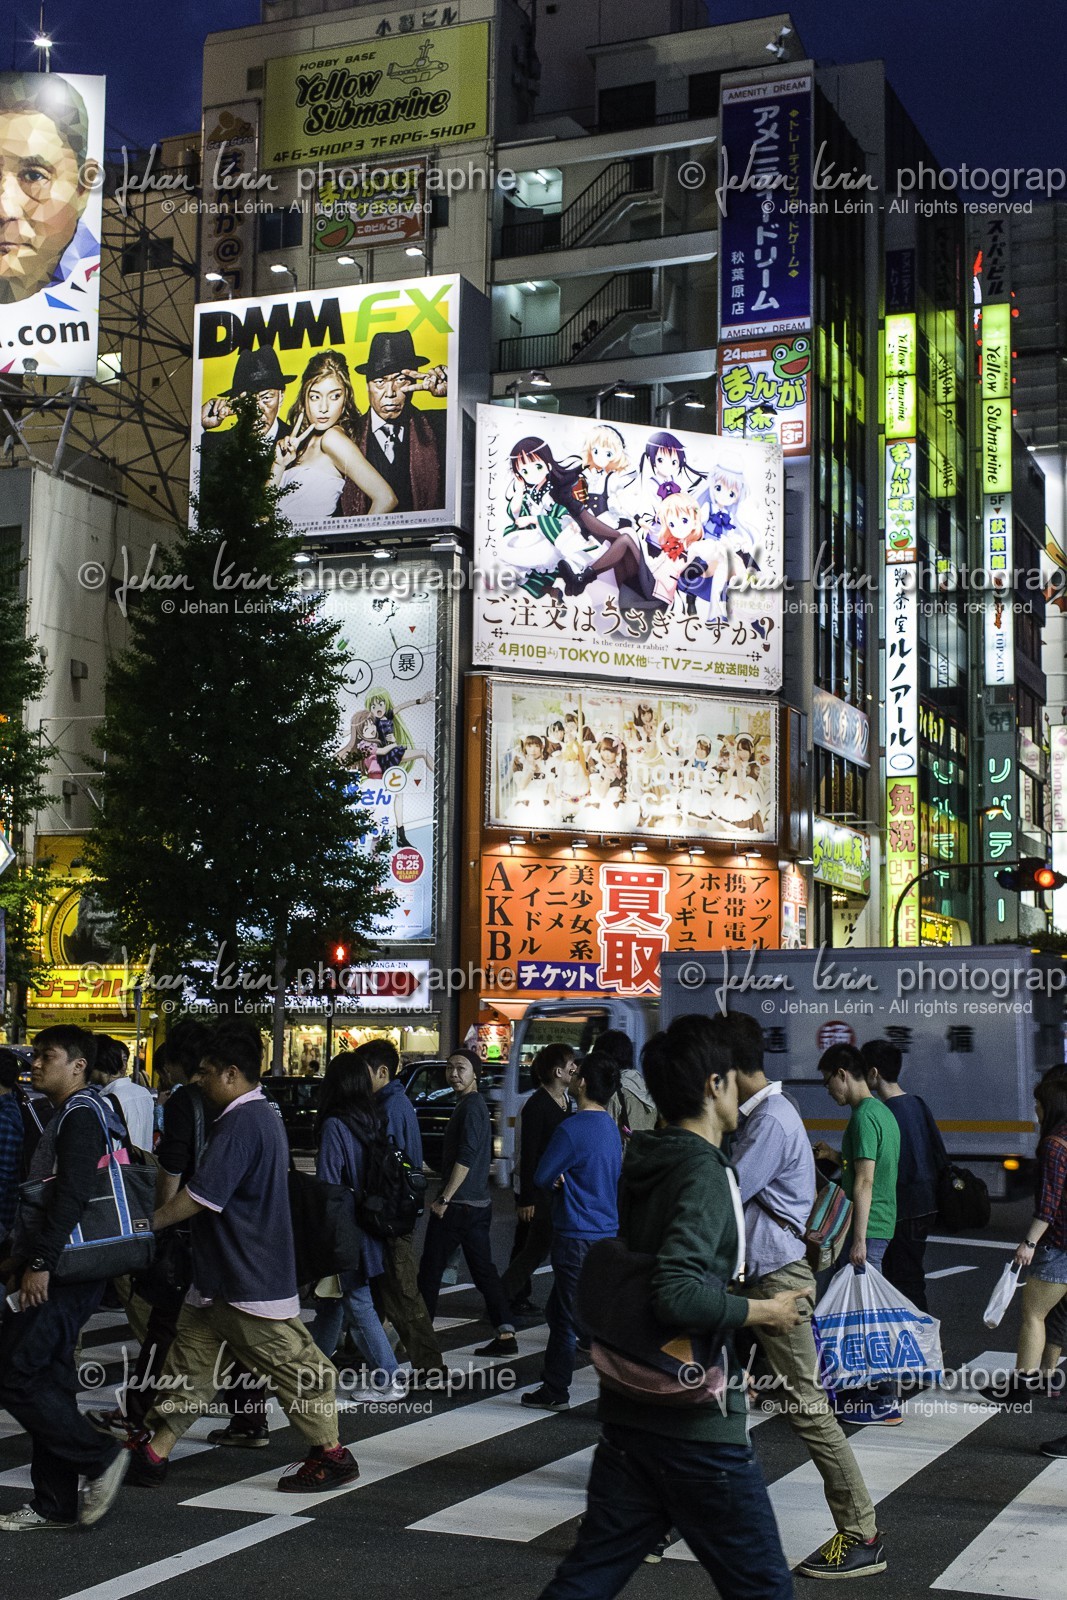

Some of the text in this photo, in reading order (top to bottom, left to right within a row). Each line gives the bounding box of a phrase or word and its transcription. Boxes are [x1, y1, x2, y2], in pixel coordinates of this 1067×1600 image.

[300, 51, 376, 71] HOBBY BASE
[296, 68, 383, 108] Yellow
[303, 88, 452, 136] Submarine
[728, 80, 807, 101] AMENITY DREAM
[730, 250, 746, 316] 秋葉原店
[0, 319, 91, 348] .com
[198, 283, 455, 360] DMM FX
[726, 321, 807, 339] AMENITY DREAM
[721, 364, 805, 408] まんが
[986, 346, 1002, 484] Yellow Submarine
[484, 434, 498, 558] ブレンドしました。
[889, 442, 912, 498] まんが
[763, 470, 778, 576] かわいさだけを、
[990, 494, 1006, 505] 5F
[398, 652, 416, 673] 暴
[601, 639, 614, 647] the
[614, 640, 634, 649] order
[889, 784, 917, 853] 免税
[988, 757, 1013, 923] リバテー
[396, 860, 420, 871] 6.25
[397, 853, 420, 861] Blu-ray
[518, 863, 543, 956] アイドル
[545, 864, 568, 932] アニメ
[570, 864, 594, 961] 美少女系
[674, 871, 698, 952] フィギュ
[700, 872, 721, 939] ホビー
[724, 872, 748, 952] 携帯電
[600, 867, 672, 991] 買取
[905, 905, 917, 946] FRE
[520, 964, 594, 989] チケット
[820, 1329, 927, 1374] SEGA
